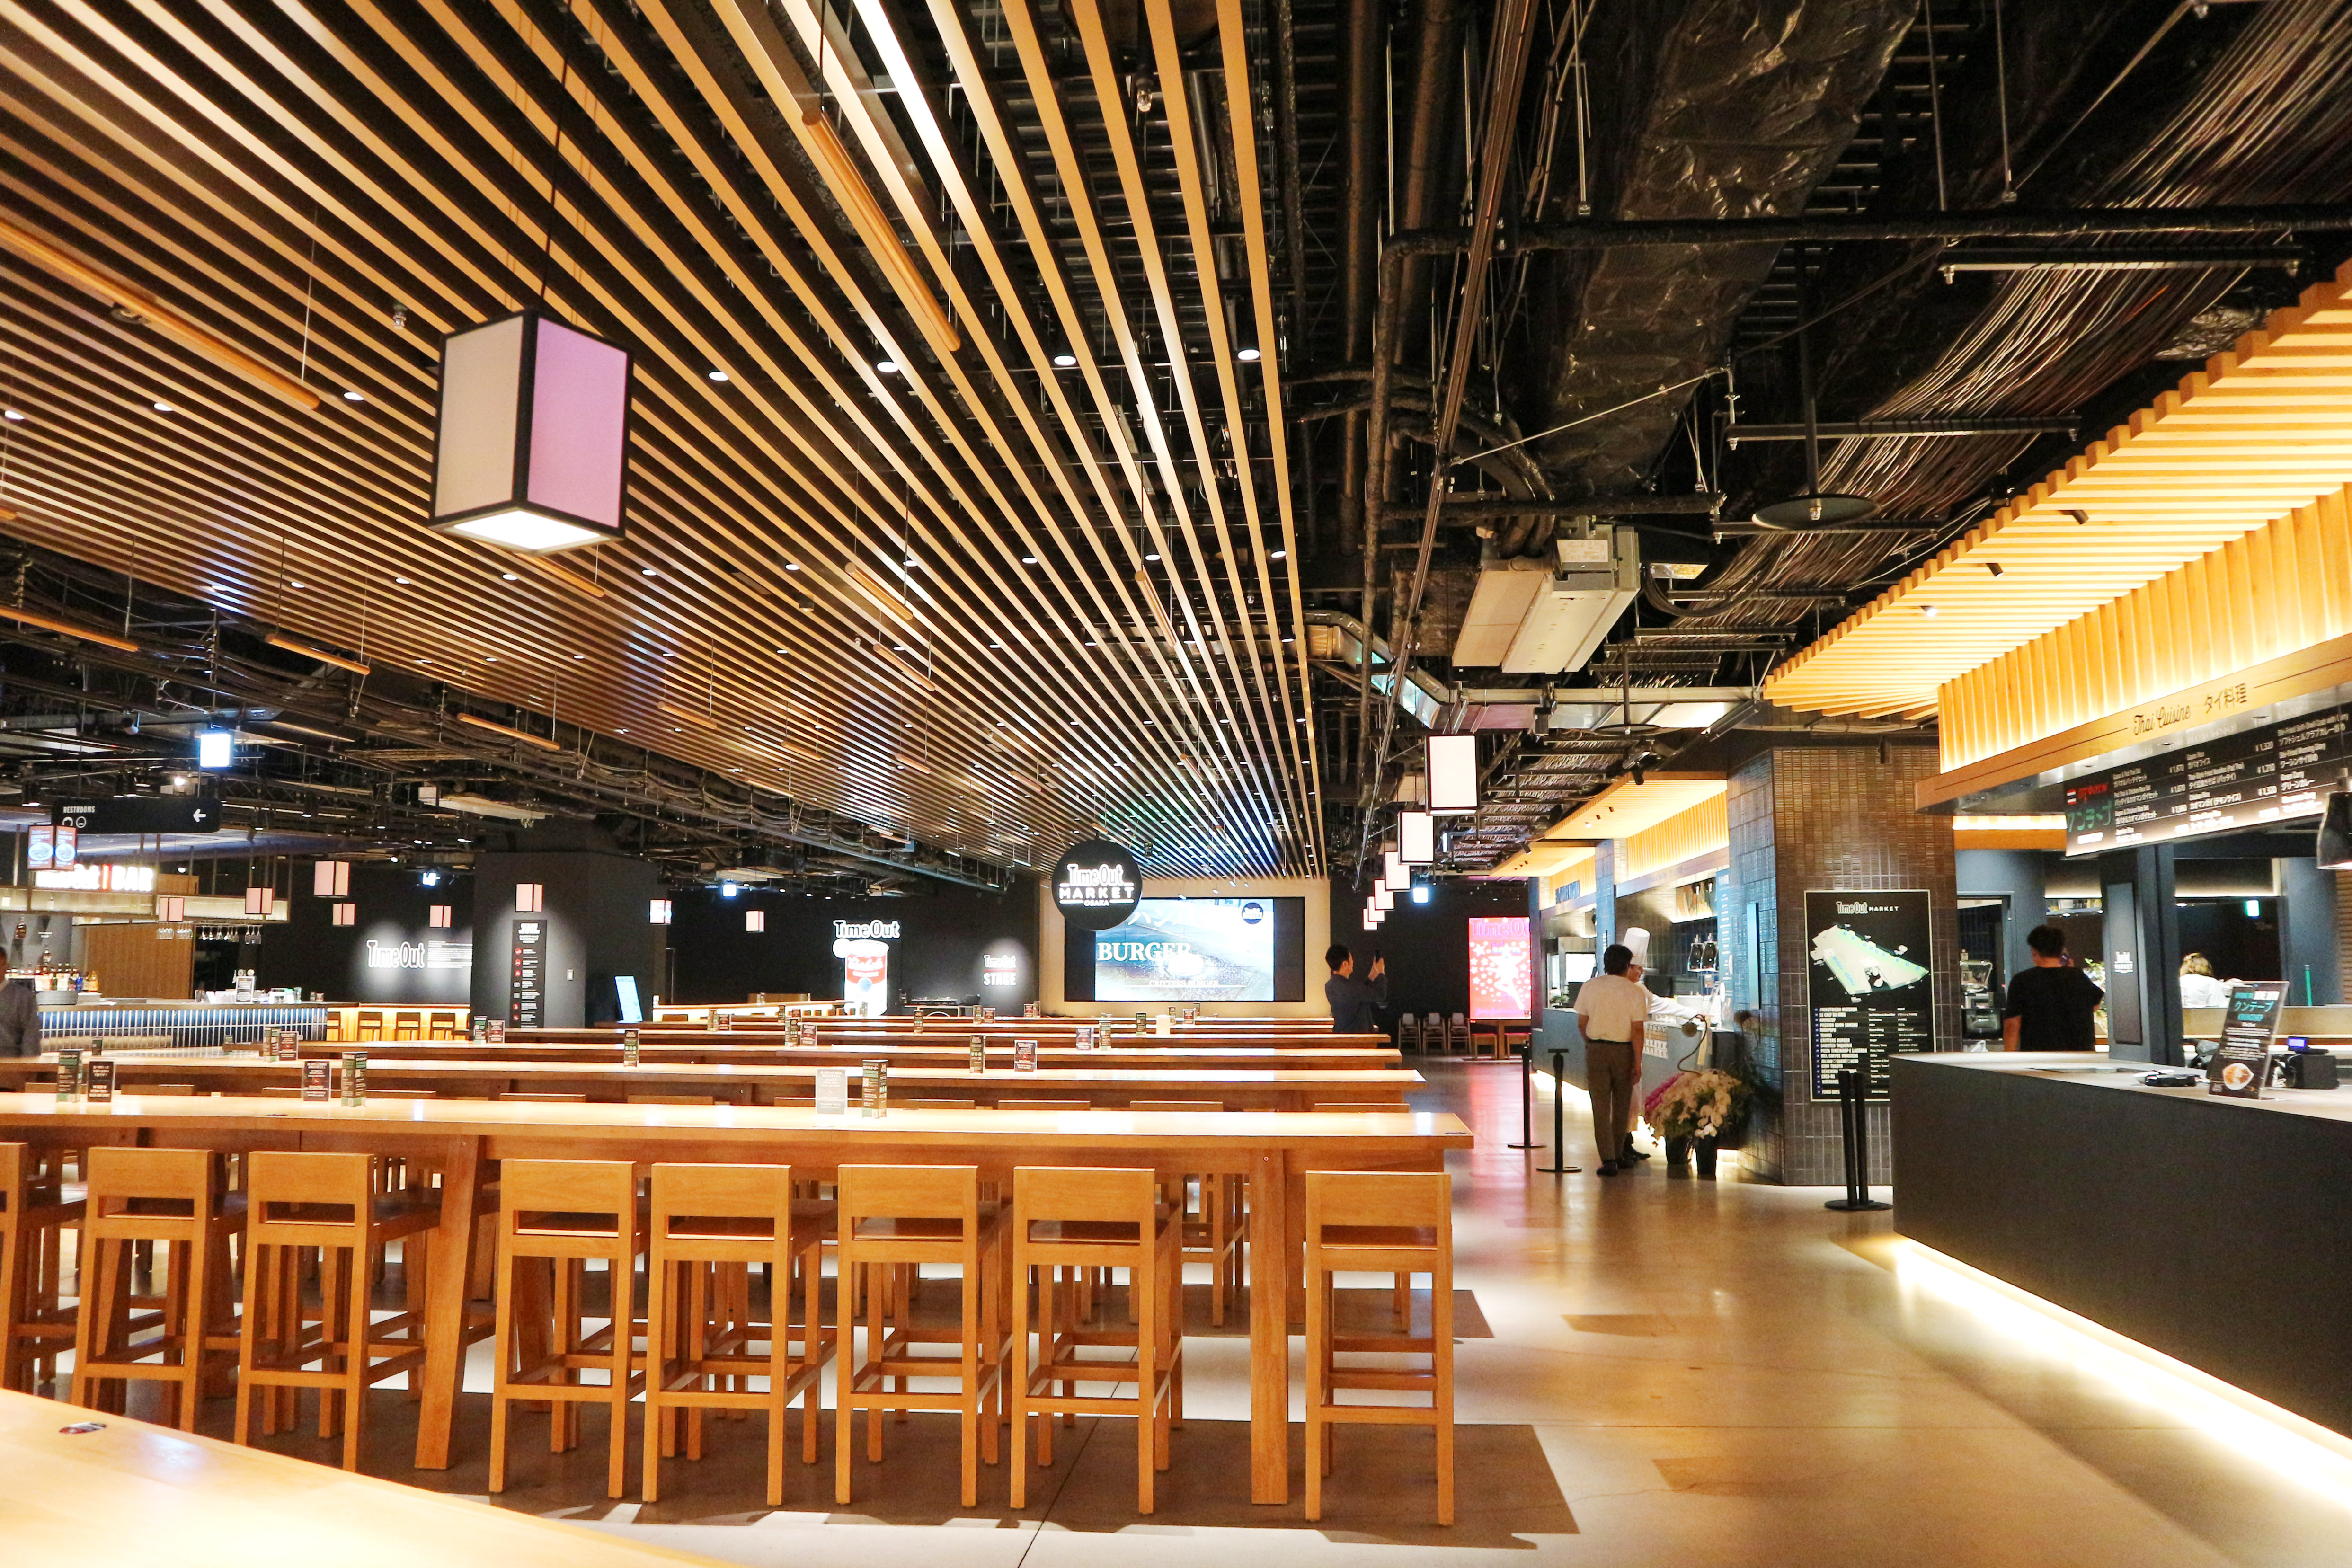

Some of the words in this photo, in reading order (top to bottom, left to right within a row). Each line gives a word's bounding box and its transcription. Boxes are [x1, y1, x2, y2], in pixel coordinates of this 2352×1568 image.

[2204, 683, 2247, 714] タイ料理
[2134, 714, 2154, 735] Thai
[2156, 705, 2191, 728] Cuisine
[111, 865, 154, 892] BAR
[1059, 887, 1135, 899] MARKET
[1097, 942, 1191, 962] BURGER
[984, 973, 1016, 985] STAGE
